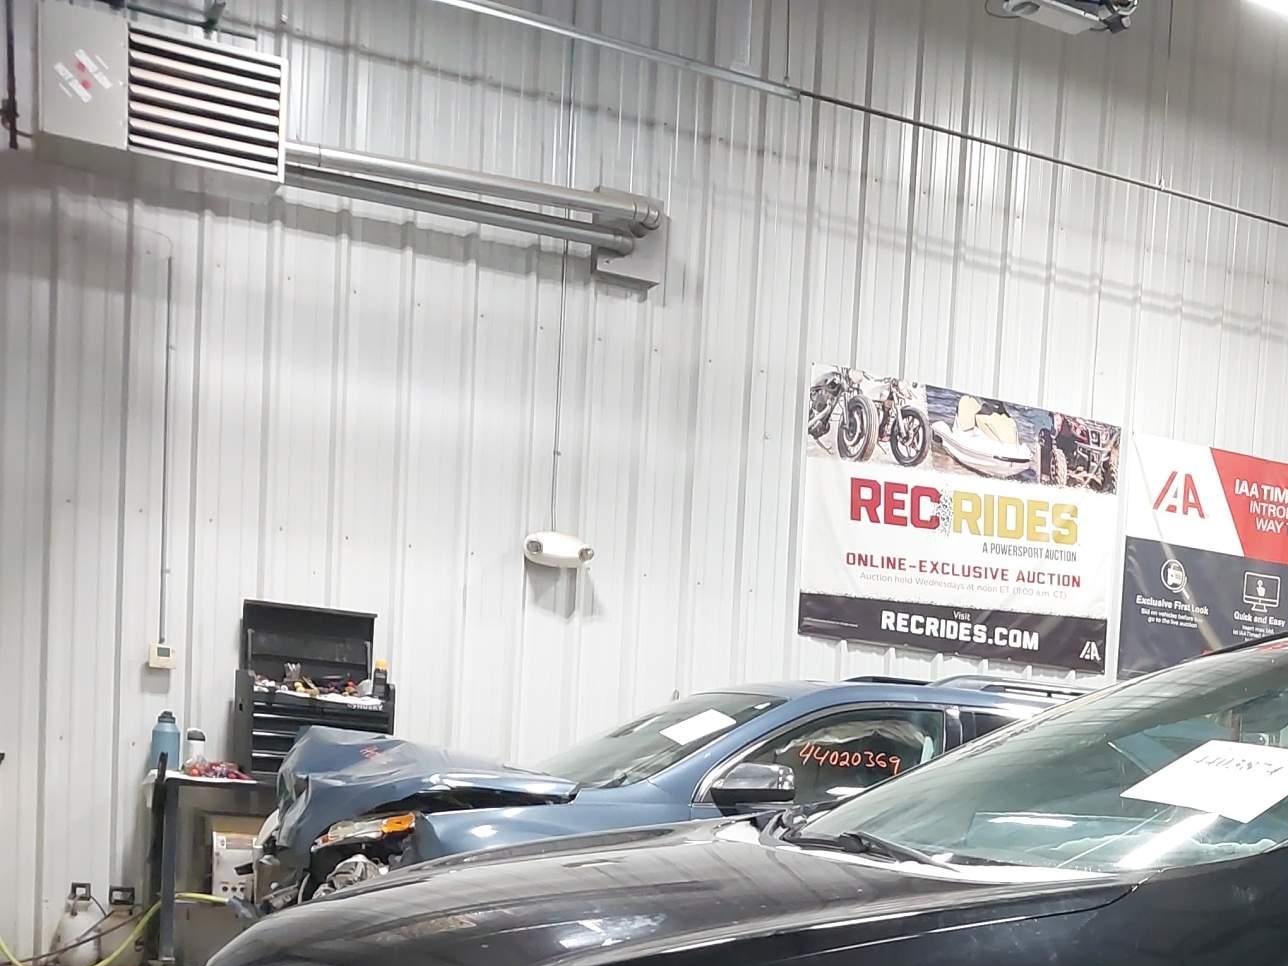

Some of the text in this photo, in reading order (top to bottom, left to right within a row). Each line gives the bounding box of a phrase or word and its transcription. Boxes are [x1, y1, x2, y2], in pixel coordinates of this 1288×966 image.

[1234, 478, 1258, 499] IAA
[850, 477, 1078, 545] REC RIDES
[1255, 516, 1285, 535] WAY
[982, 542, 1077, 563] A POWERSPORT AUCTION
[846, 552, 1081, 588] ONLINE-EXCLUSIVE AUCTION
[859, 571, 894, 584] Auction
[894, 576, 913, 586] held
[915, 577, 965, 592] Wednesdays
[966, 583, 974, 592] at
[976, 585, 998, 594] noon
[953, 610, 971, 622] Visit
[1135, 594, 1209, 616] Exclusive First Look
[1233, 610, 1287, 628] Quick and Easy
[881, 610, 1040, 651] RECRIDES.COM
[799, 741, 902, 776] 44020369
